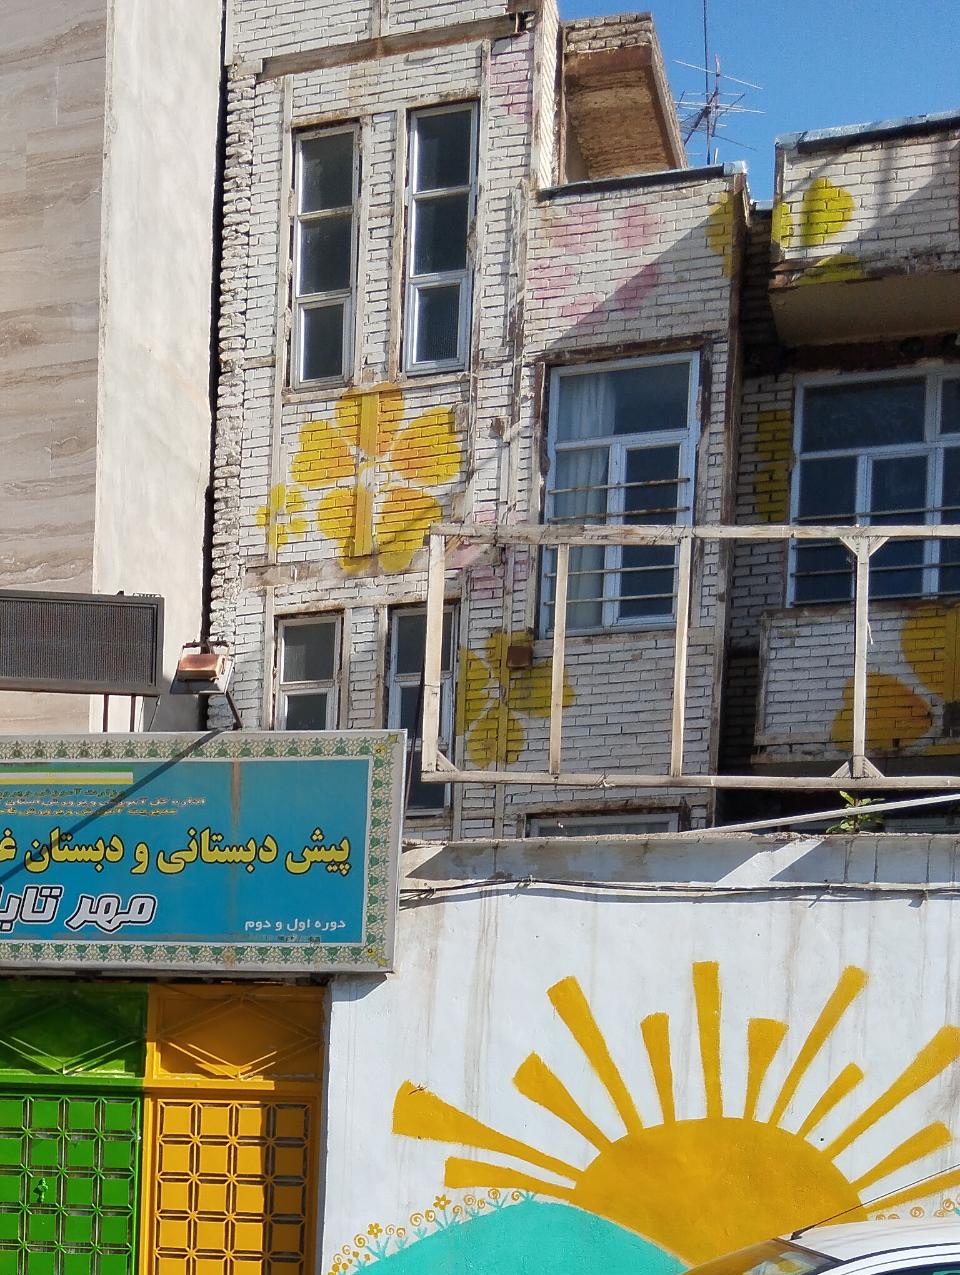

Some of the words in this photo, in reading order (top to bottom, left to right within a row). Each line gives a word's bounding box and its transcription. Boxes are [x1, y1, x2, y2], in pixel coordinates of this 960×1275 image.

[24, 827, 125, 873] دبستان
[130, 841, 150, 875] و
[156, 827, 278, 874] دبستانی
[285, 827, 351, 876] پیش
[64, 893, 158, 934] مهر
[244, 919, 271, 931] دوم
[275, 919, 282, 931] و
[286, 918, 310, 931] اول
[314, 919, 346, 931] دوره
